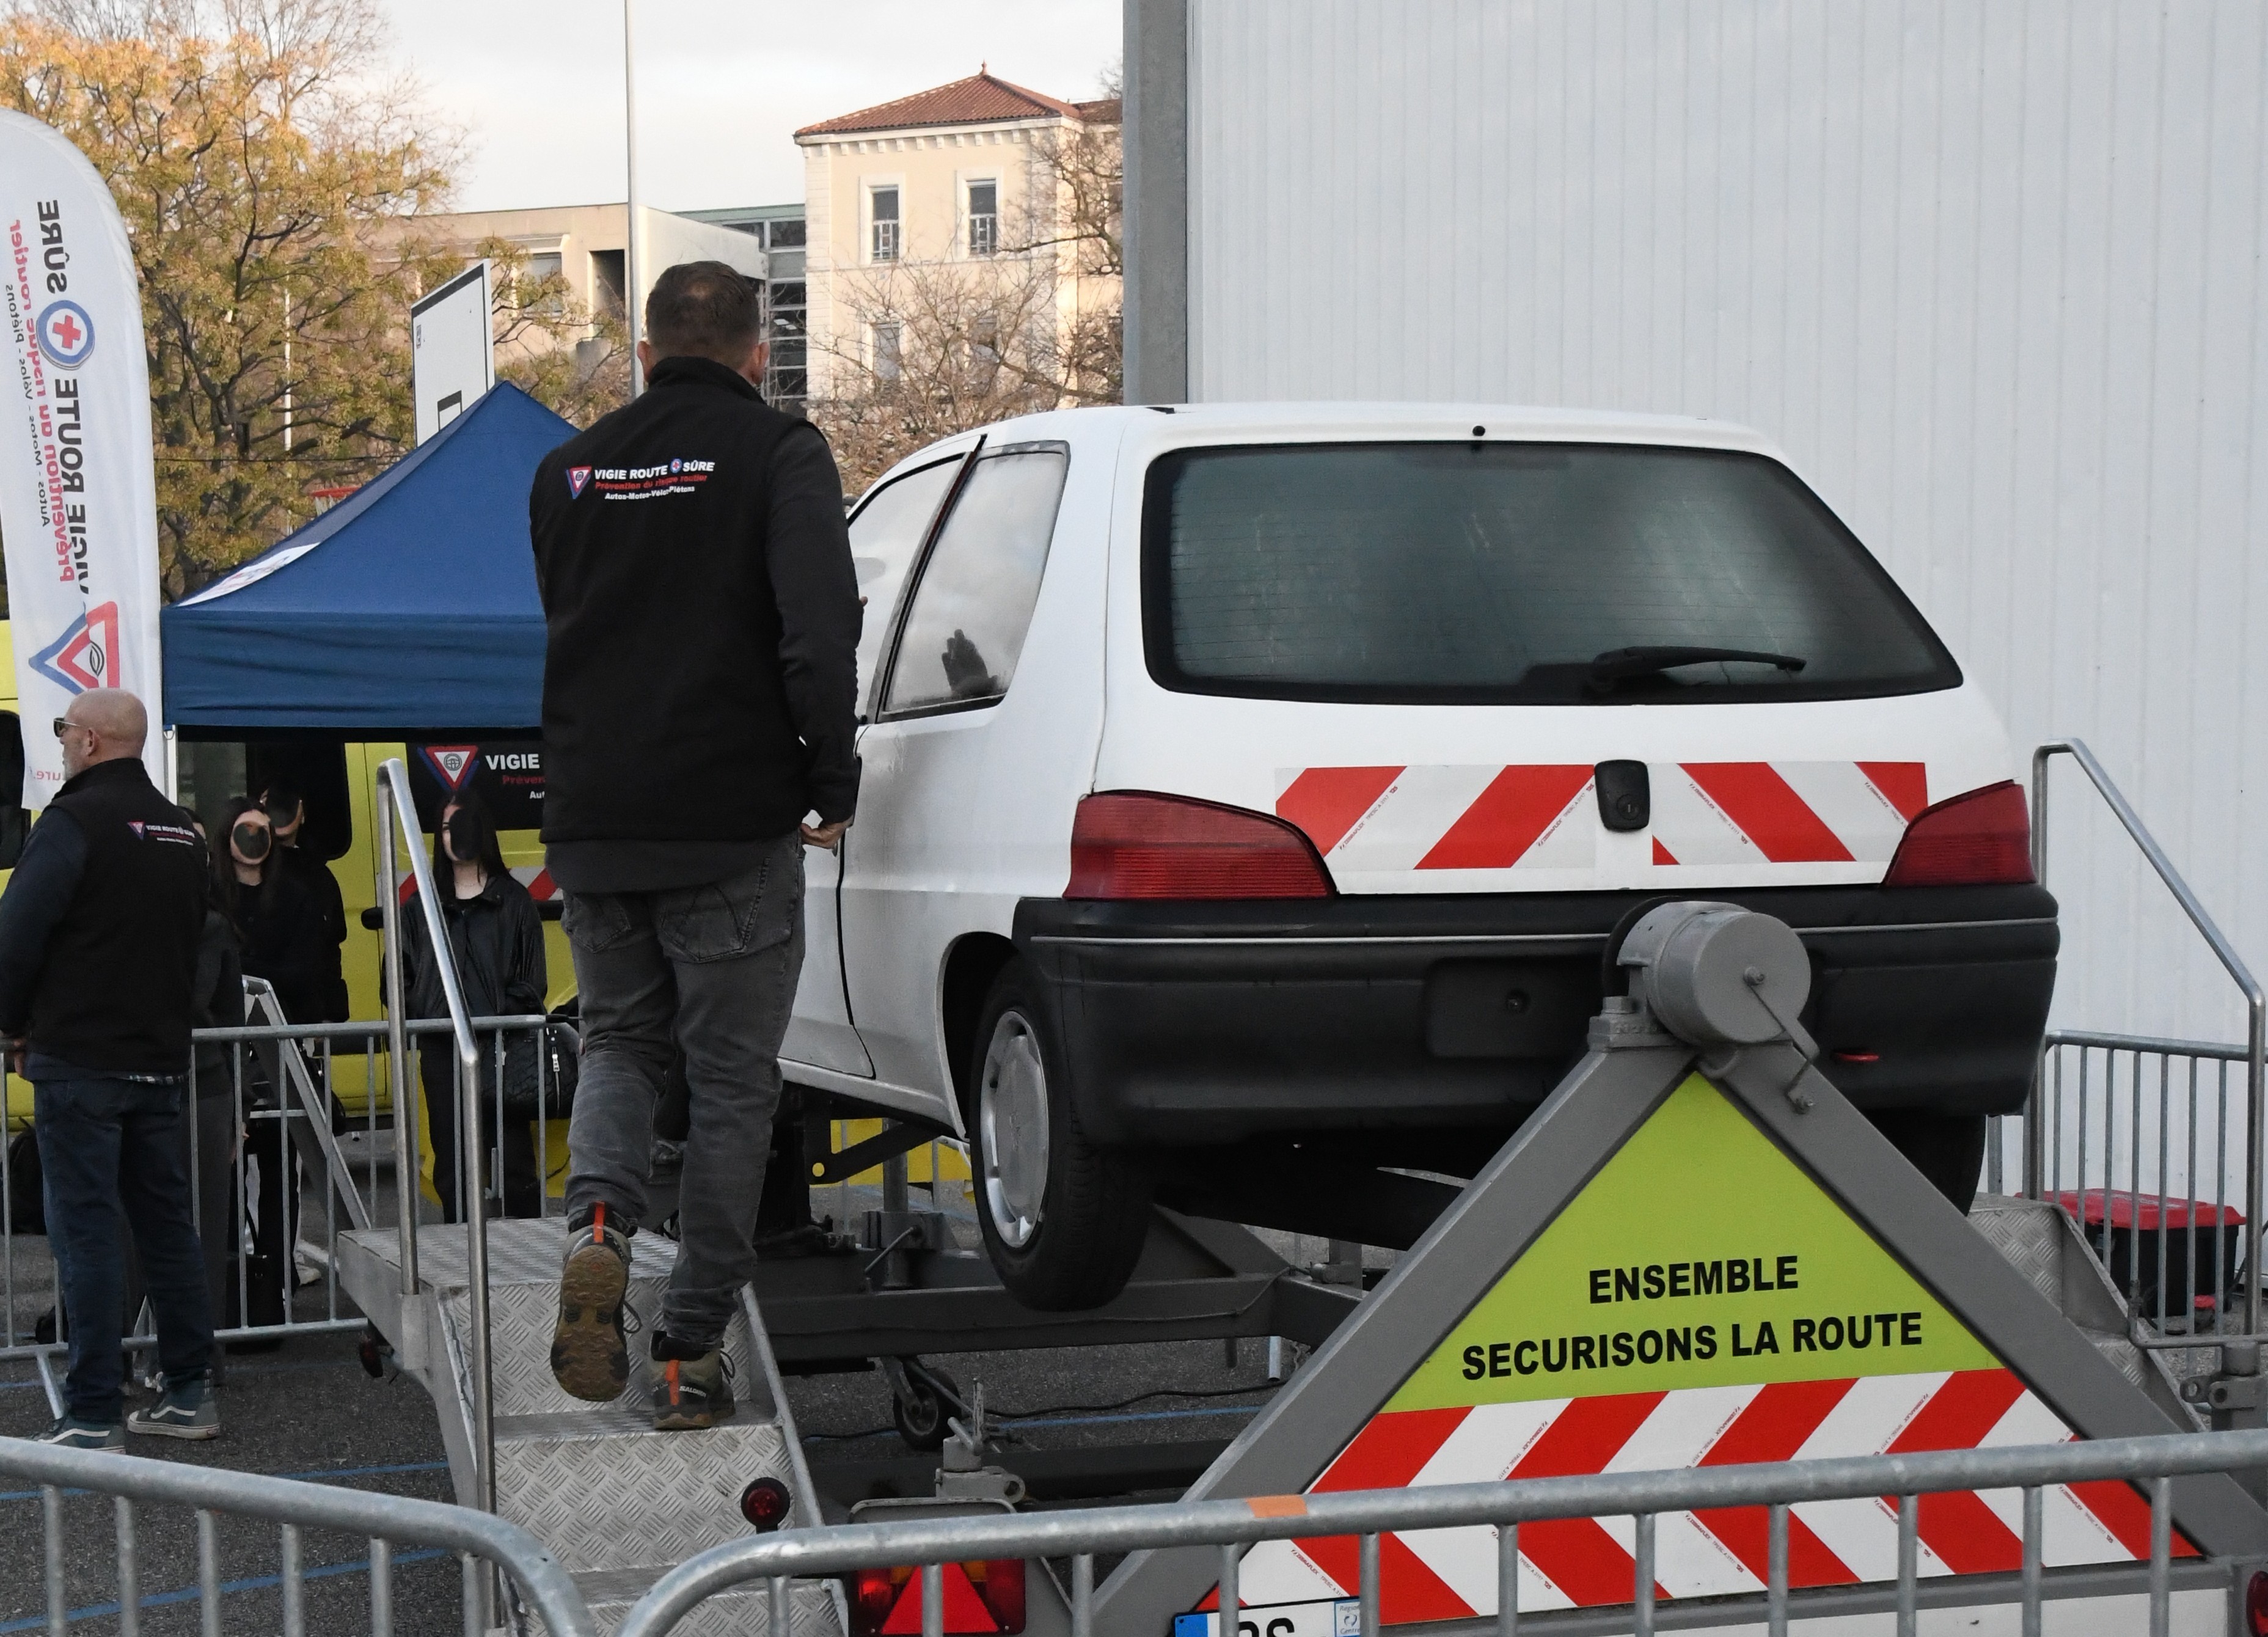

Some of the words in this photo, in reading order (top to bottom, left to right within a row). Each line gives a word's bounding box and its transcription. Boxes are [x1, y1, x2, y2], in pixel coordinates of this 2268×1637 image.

[594, 469, 627, 480] VIGIE
[629, 465, 668, 479] ROUTE
[682, 460, 715, 472] SÛRE
[485, 753, 540, 770] VIGIE
[1589, 1256, 1798, 1304] ENSEMBLE
[1461, 1325, 1717, 1380] SECURISONS
[1731, 1320, 1780, 1357] LA
[1793, 1312, 1922, 1353] ROUTE
